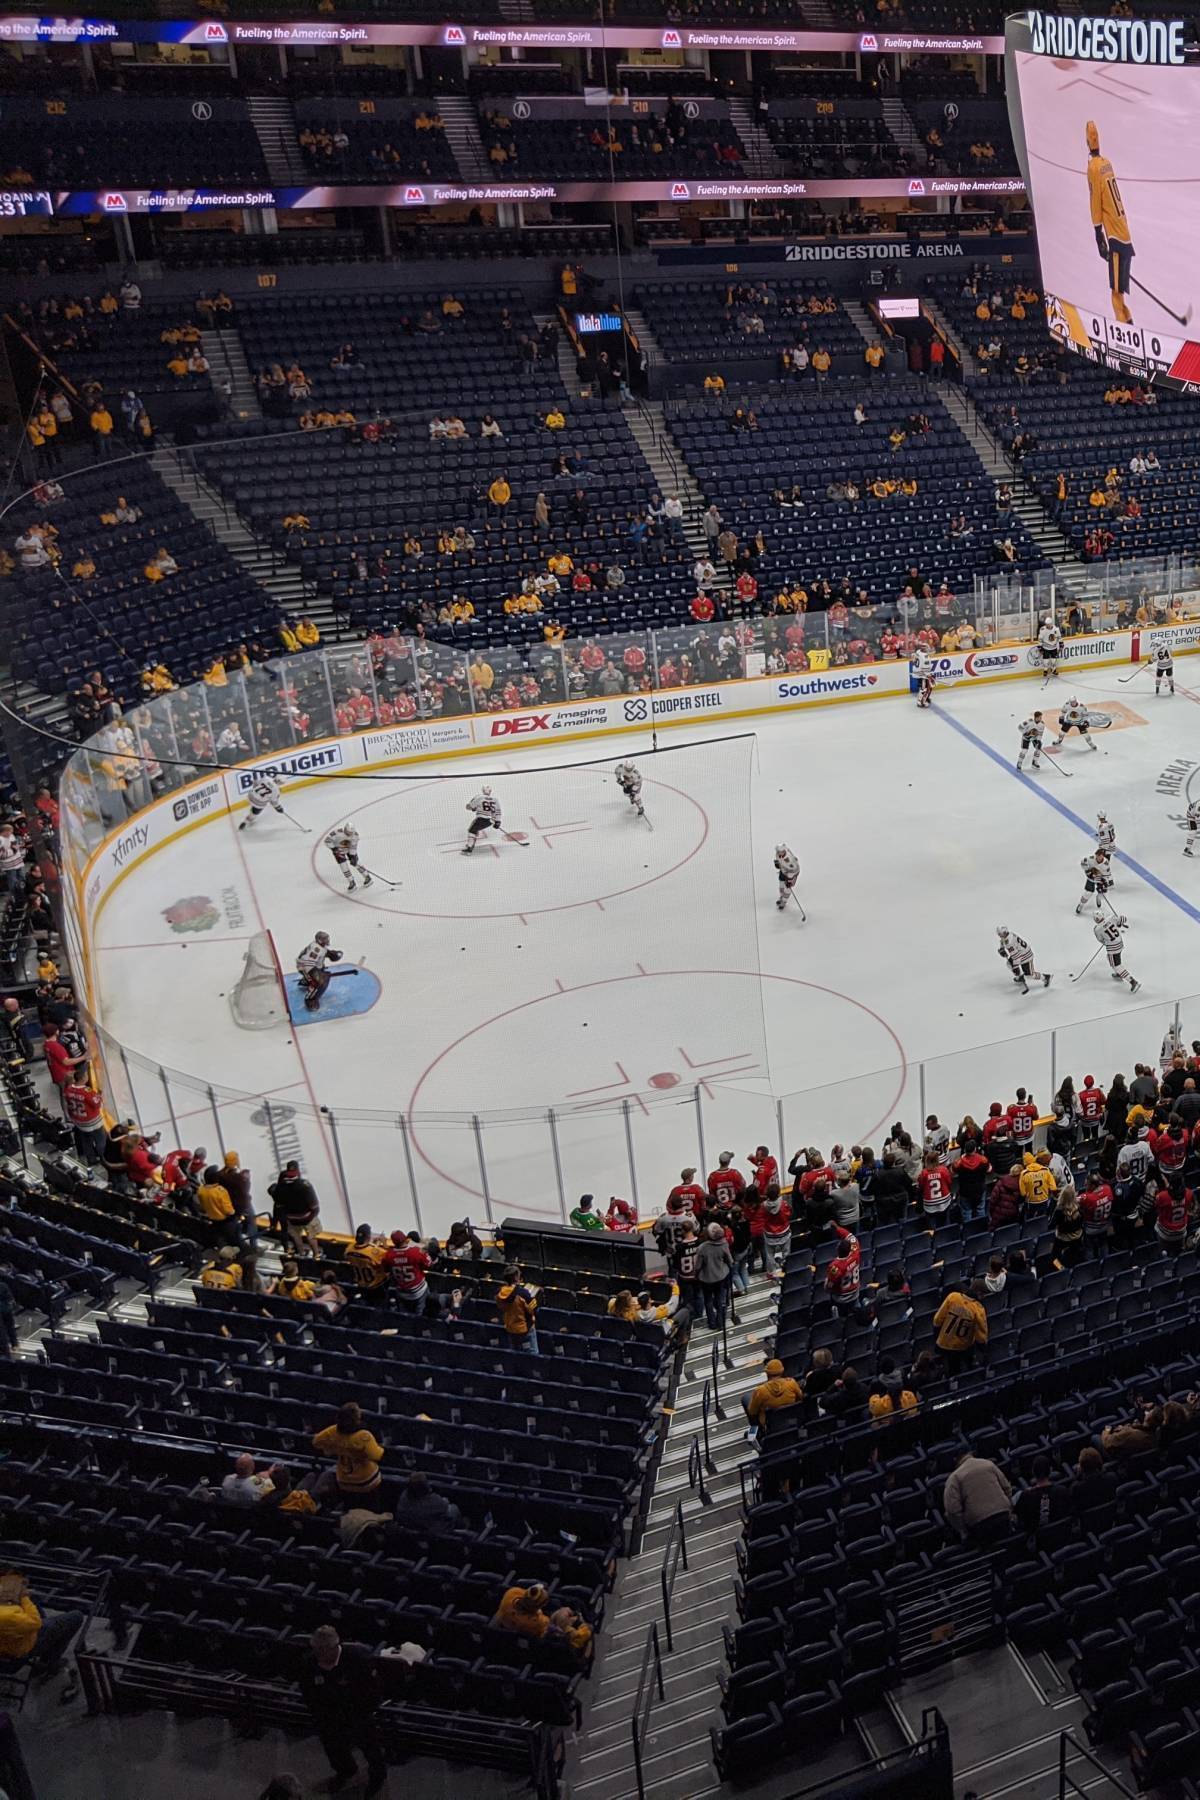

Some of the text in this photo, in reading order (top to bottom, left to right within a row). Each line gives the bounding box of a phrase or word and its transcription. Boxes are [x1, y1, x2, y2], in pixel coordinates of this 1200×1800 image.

[13, 24, 31, 34] the
[32, 25, 86, 35] American
[87, 25, 118, 37] Spirit.
[236, 27, 368, 40] Fueling the American Spirit.
[473, 31, 592, 43] Fueling the American Spirit.
[1028, 11, 1184, 64] BRIDGESTONE
[688, 34, 797, 46] Fueling the American Spirit.
[884, 38, 983, 50] Fueling the American Spirit.
[434, 187, 557, 200] Fueling the American Spirit.
[697, 184, 807, 196] Fueling the American Spirit.
[931, 182, 958, 192] Fueling
[959, 181, 970, 190] the
[972, 181, 1005, 190] American
[137, 193, 275, 207] Fueling the American Spirit.
[785, 244, 963, 261] BRIDGESTONE ARENA
[1109, 325, 1140, 348] 13:10
[1106, 356, 1121, 372] NYK
[1157, 649, 1169, 660] 64
[930, 658, 951, 672] 70
[778, 673, 866, 698] Southwest
[652, 692, 722, 714] COOPER STEEL
[557, 708, 606, 720] imaging
[490, 713, 552, 737] DEX
[562, 715, 607, 728] mailing
[367, 728, 427, 745] BRENTWOOD
[432, 730, 456, 738] Mergers
[433, 734, 470, 745] Acquisitions
[383, 743, 429, 756] ADVISORS
[388, 736, 428, 749] CAPITAL
[279, 749, 337, 774] LIGHT
[1156, 758, 1197, 797] ARENA
[111, 823, 150, 867] xfinity
[1013, 1117, 1032, 1133] 88
[930, 1180, 941, 1198] 2
[945, 1312, 971, 1338] 76
